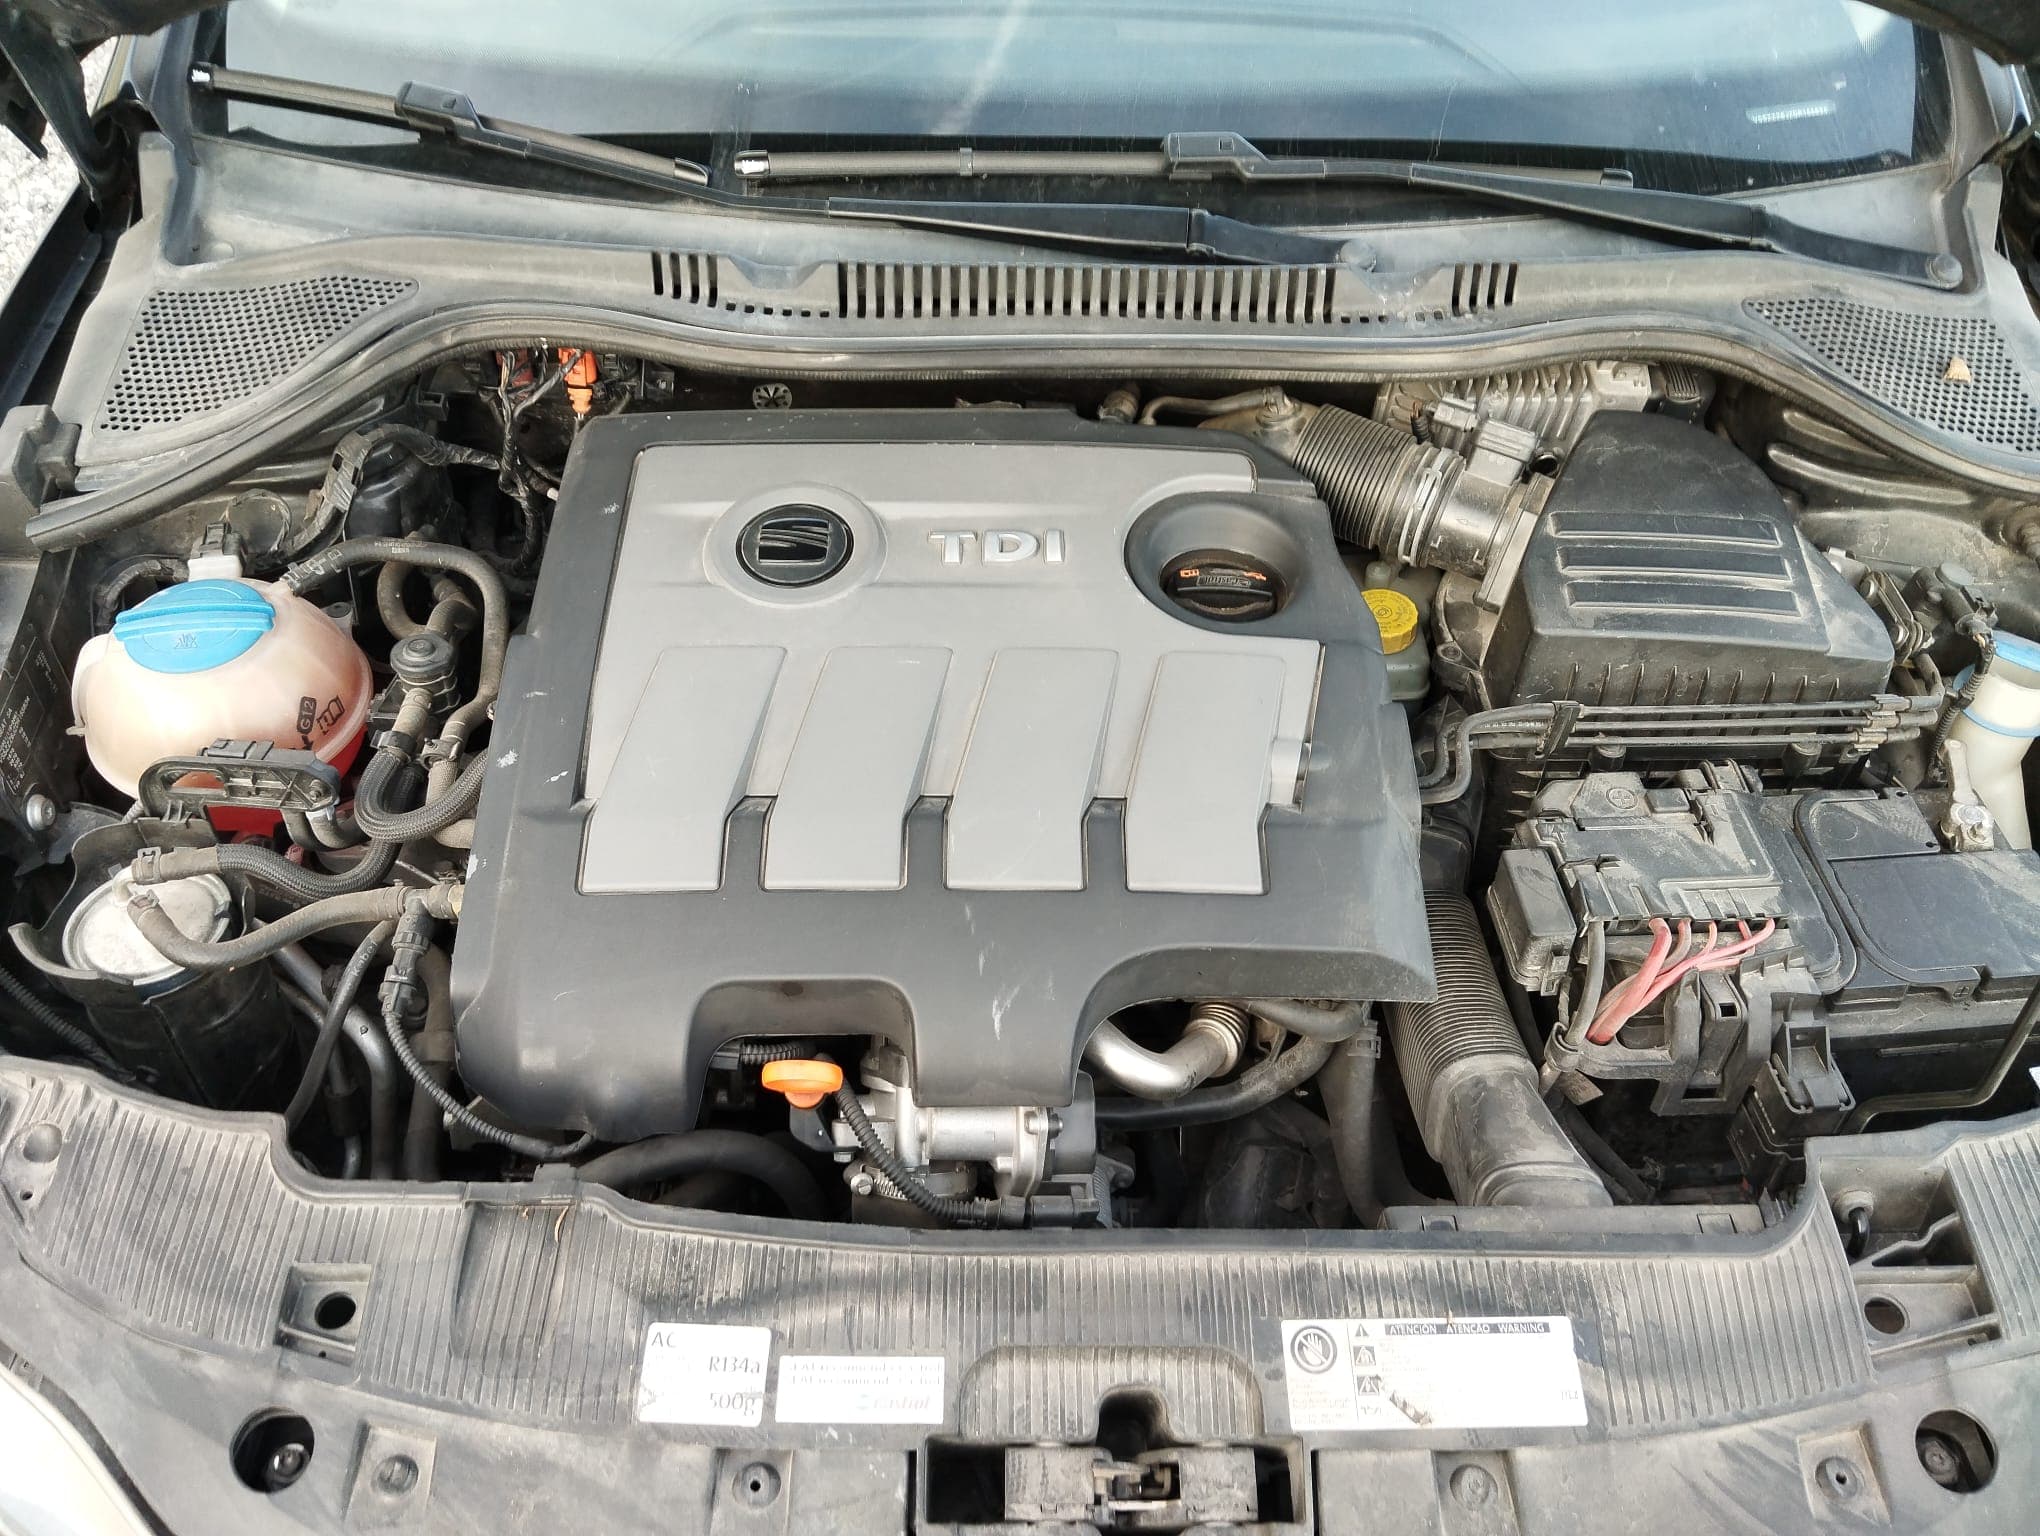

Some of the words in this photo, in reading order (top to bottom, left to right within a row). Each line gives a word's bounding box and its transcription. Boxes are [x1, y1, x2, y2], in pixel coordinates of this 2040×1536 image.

[927, 528, 1066, 566] TDI
[300, 699, 315, 730] G12
[650, 1330, 679, 1348] AC
[1497, 1322, 1545, 1334] WARNING
[708, 1355, 761, 1374] R134a
[709, 1391, 757, 1417] 500g
